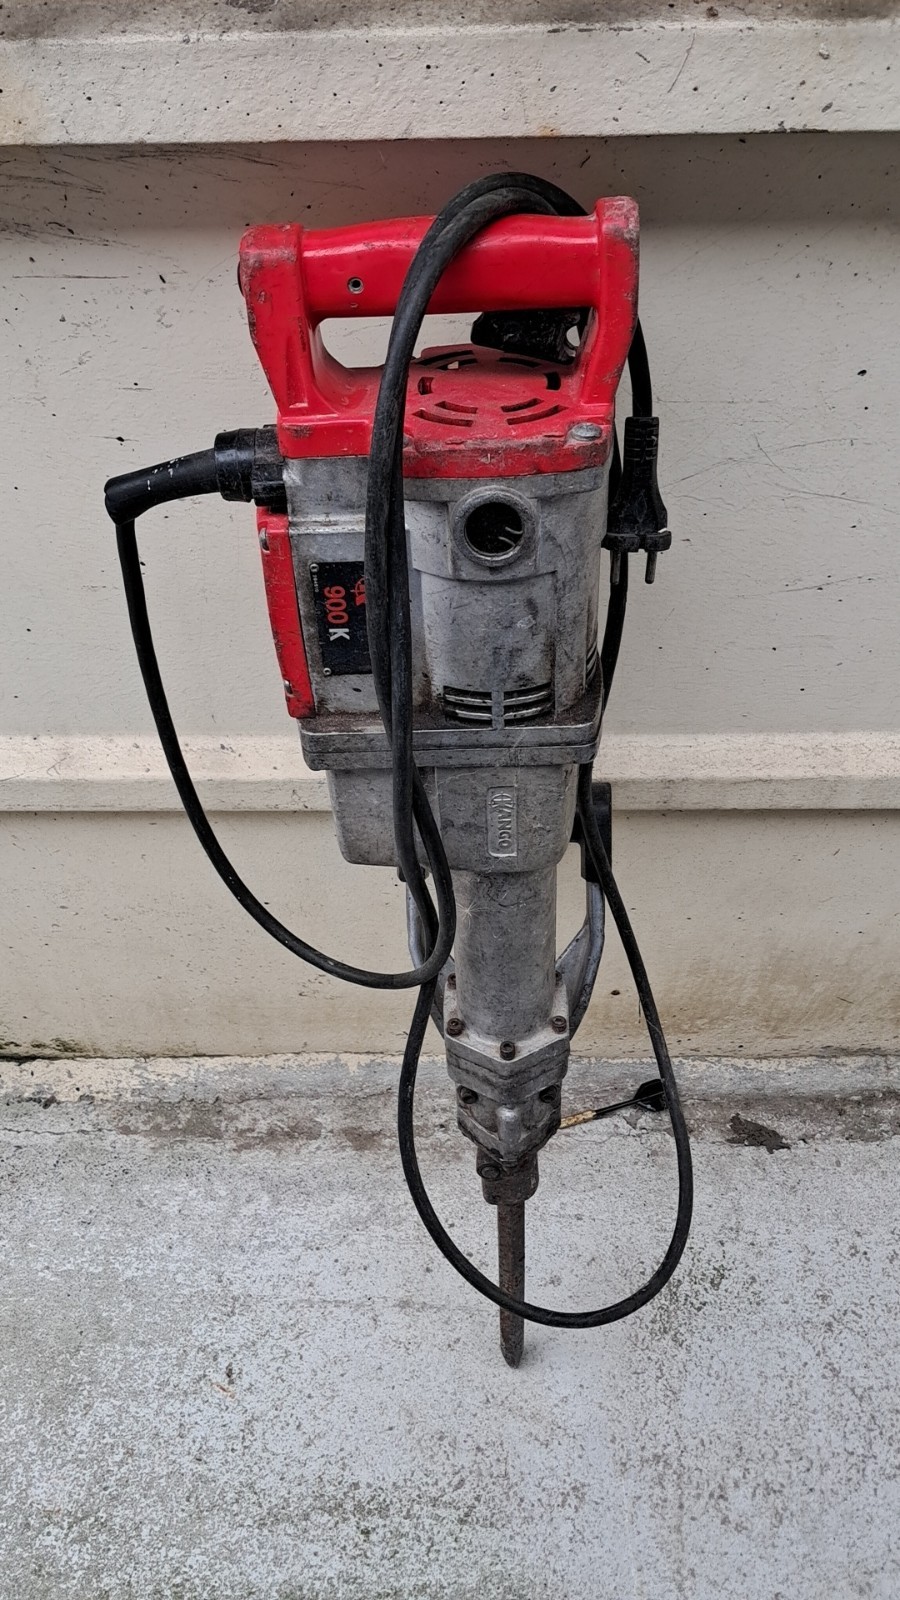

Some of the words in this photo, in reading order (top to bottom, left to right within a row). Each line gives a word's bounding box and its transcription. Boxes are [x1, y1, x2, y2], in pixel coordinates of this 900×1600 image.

[323, 585, 349, 625] 900
[328, 628, 350, 642] K
[490, 792, 515, 849] KANGO
